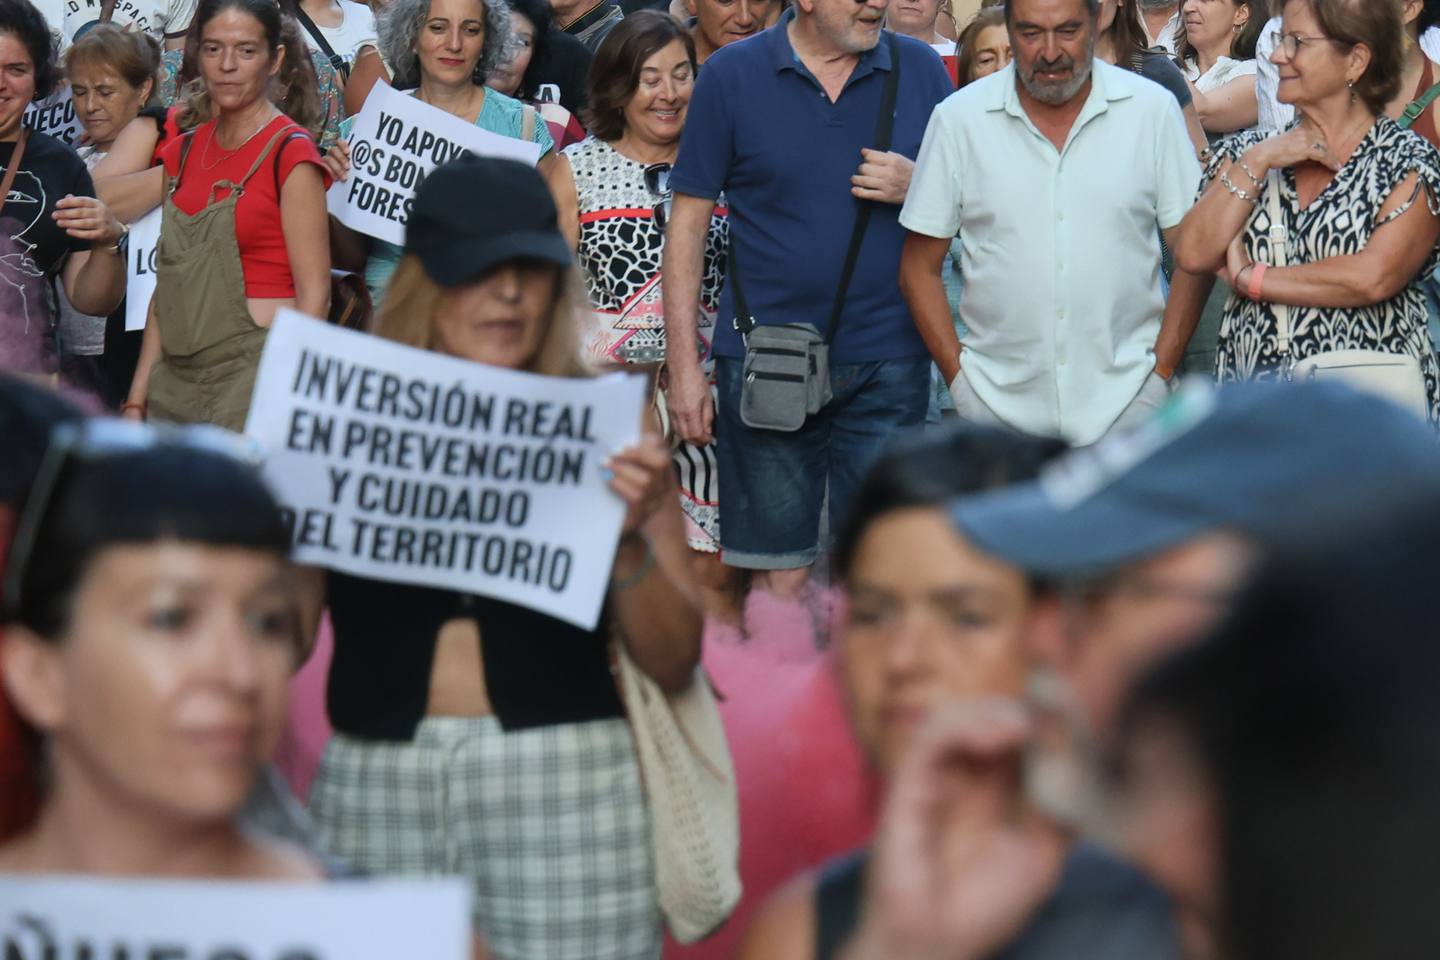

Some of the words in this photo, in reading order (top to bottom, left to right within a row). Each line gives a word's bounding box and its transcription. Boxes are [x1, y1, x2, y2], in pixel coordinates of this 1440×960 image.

[375, 111, 404, 147] YO
[402, 126, 473, 166] APOY
[291, 349, 497, 434] INVERSIÓN
[504, 398, 596, 445] REAL
[287, 409, 334, 456] EN
[341, 420, 586, 485] PREVENCIÓN
[327, 466, 350, 503] Y
[356, 471, 532, 528] CUIDADO
[349, 519, 574, 593] TERRITORIO
